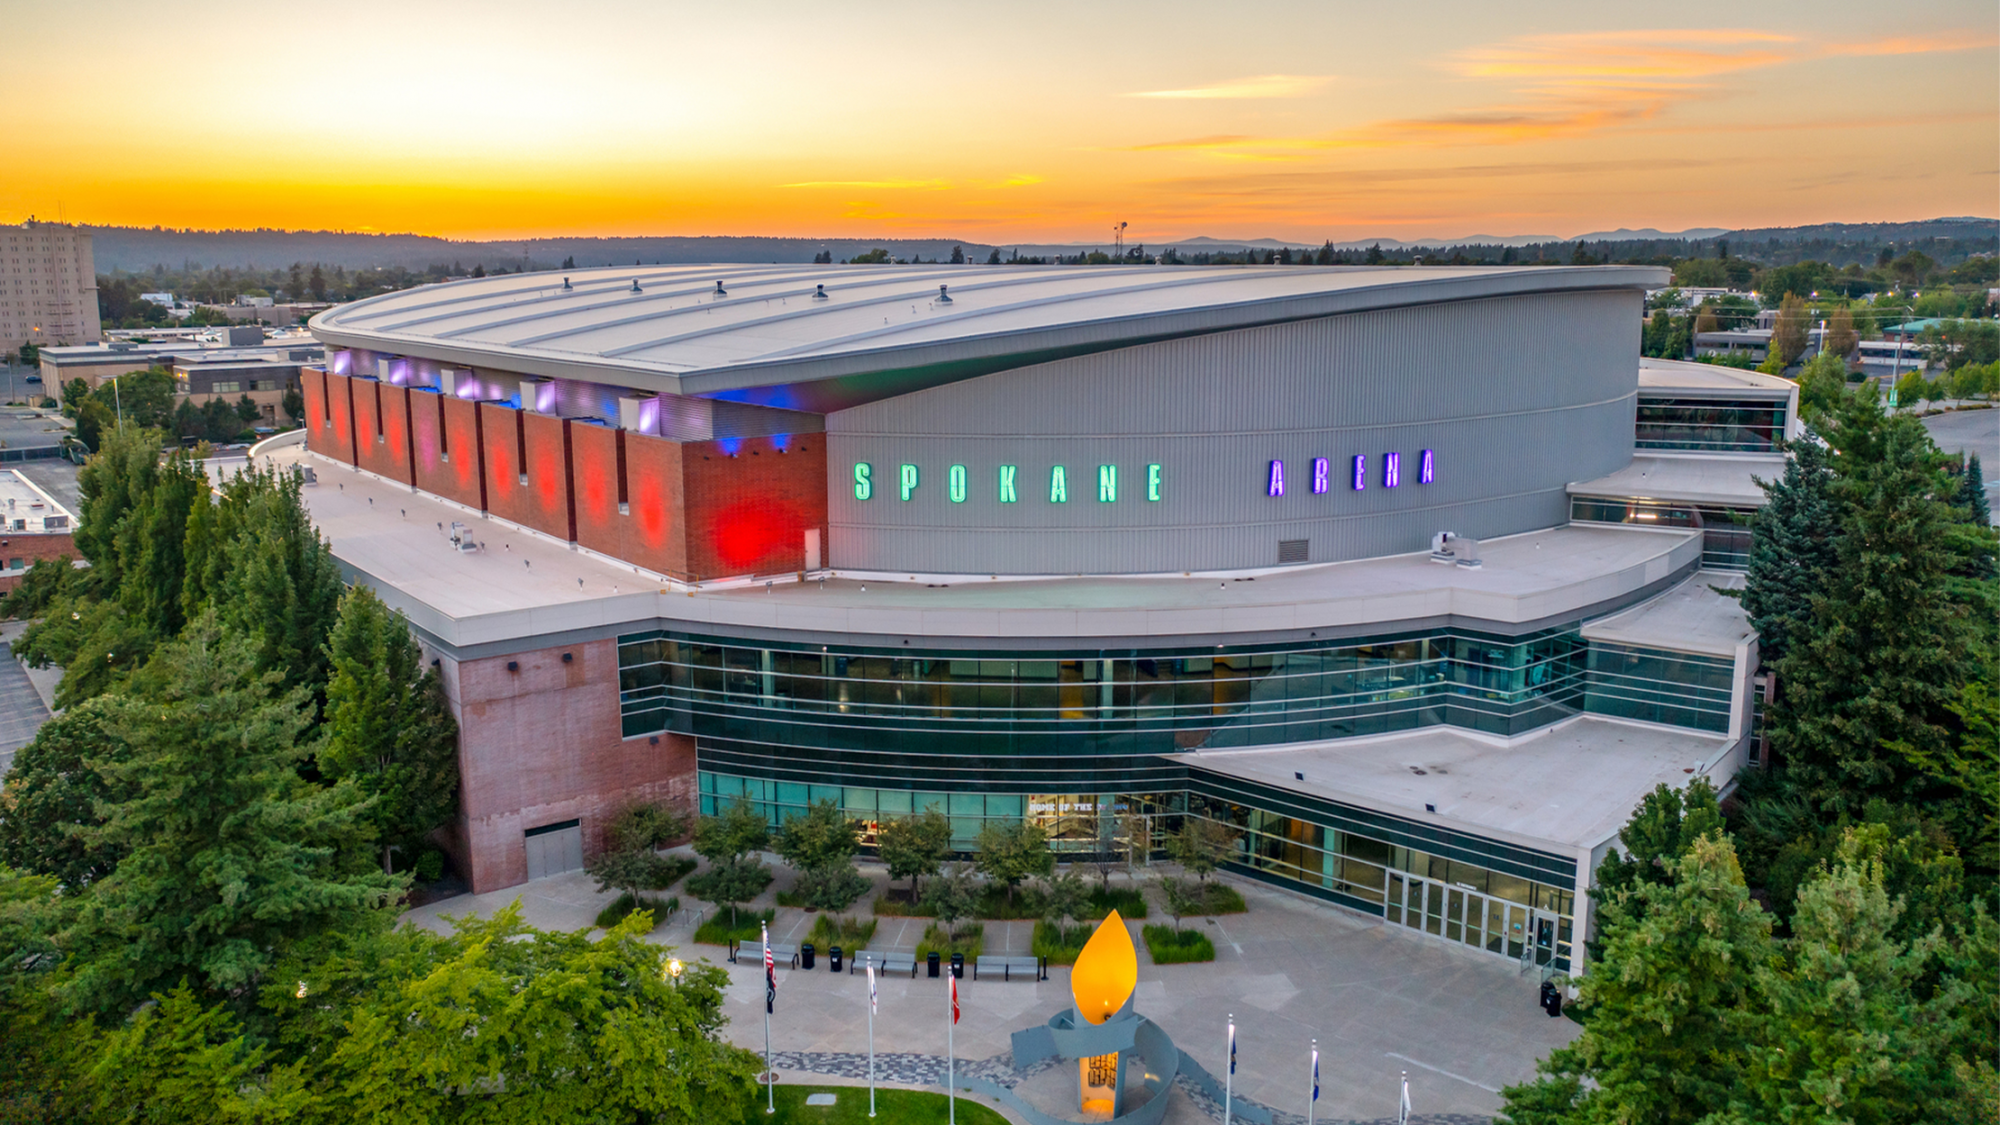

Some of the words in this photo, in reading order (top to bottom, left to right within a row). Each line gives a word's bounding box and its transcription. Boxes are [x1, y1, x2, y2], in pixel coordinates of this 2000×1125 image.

[853, 462, 1163, 503] SPOKANE
[1266, 448, 1435, 498] ARENA
[1029, 803, 1056, 811] HOME
[1058, 803, 1070, 811] OF
[1073, 803, 1093, 811] THE
